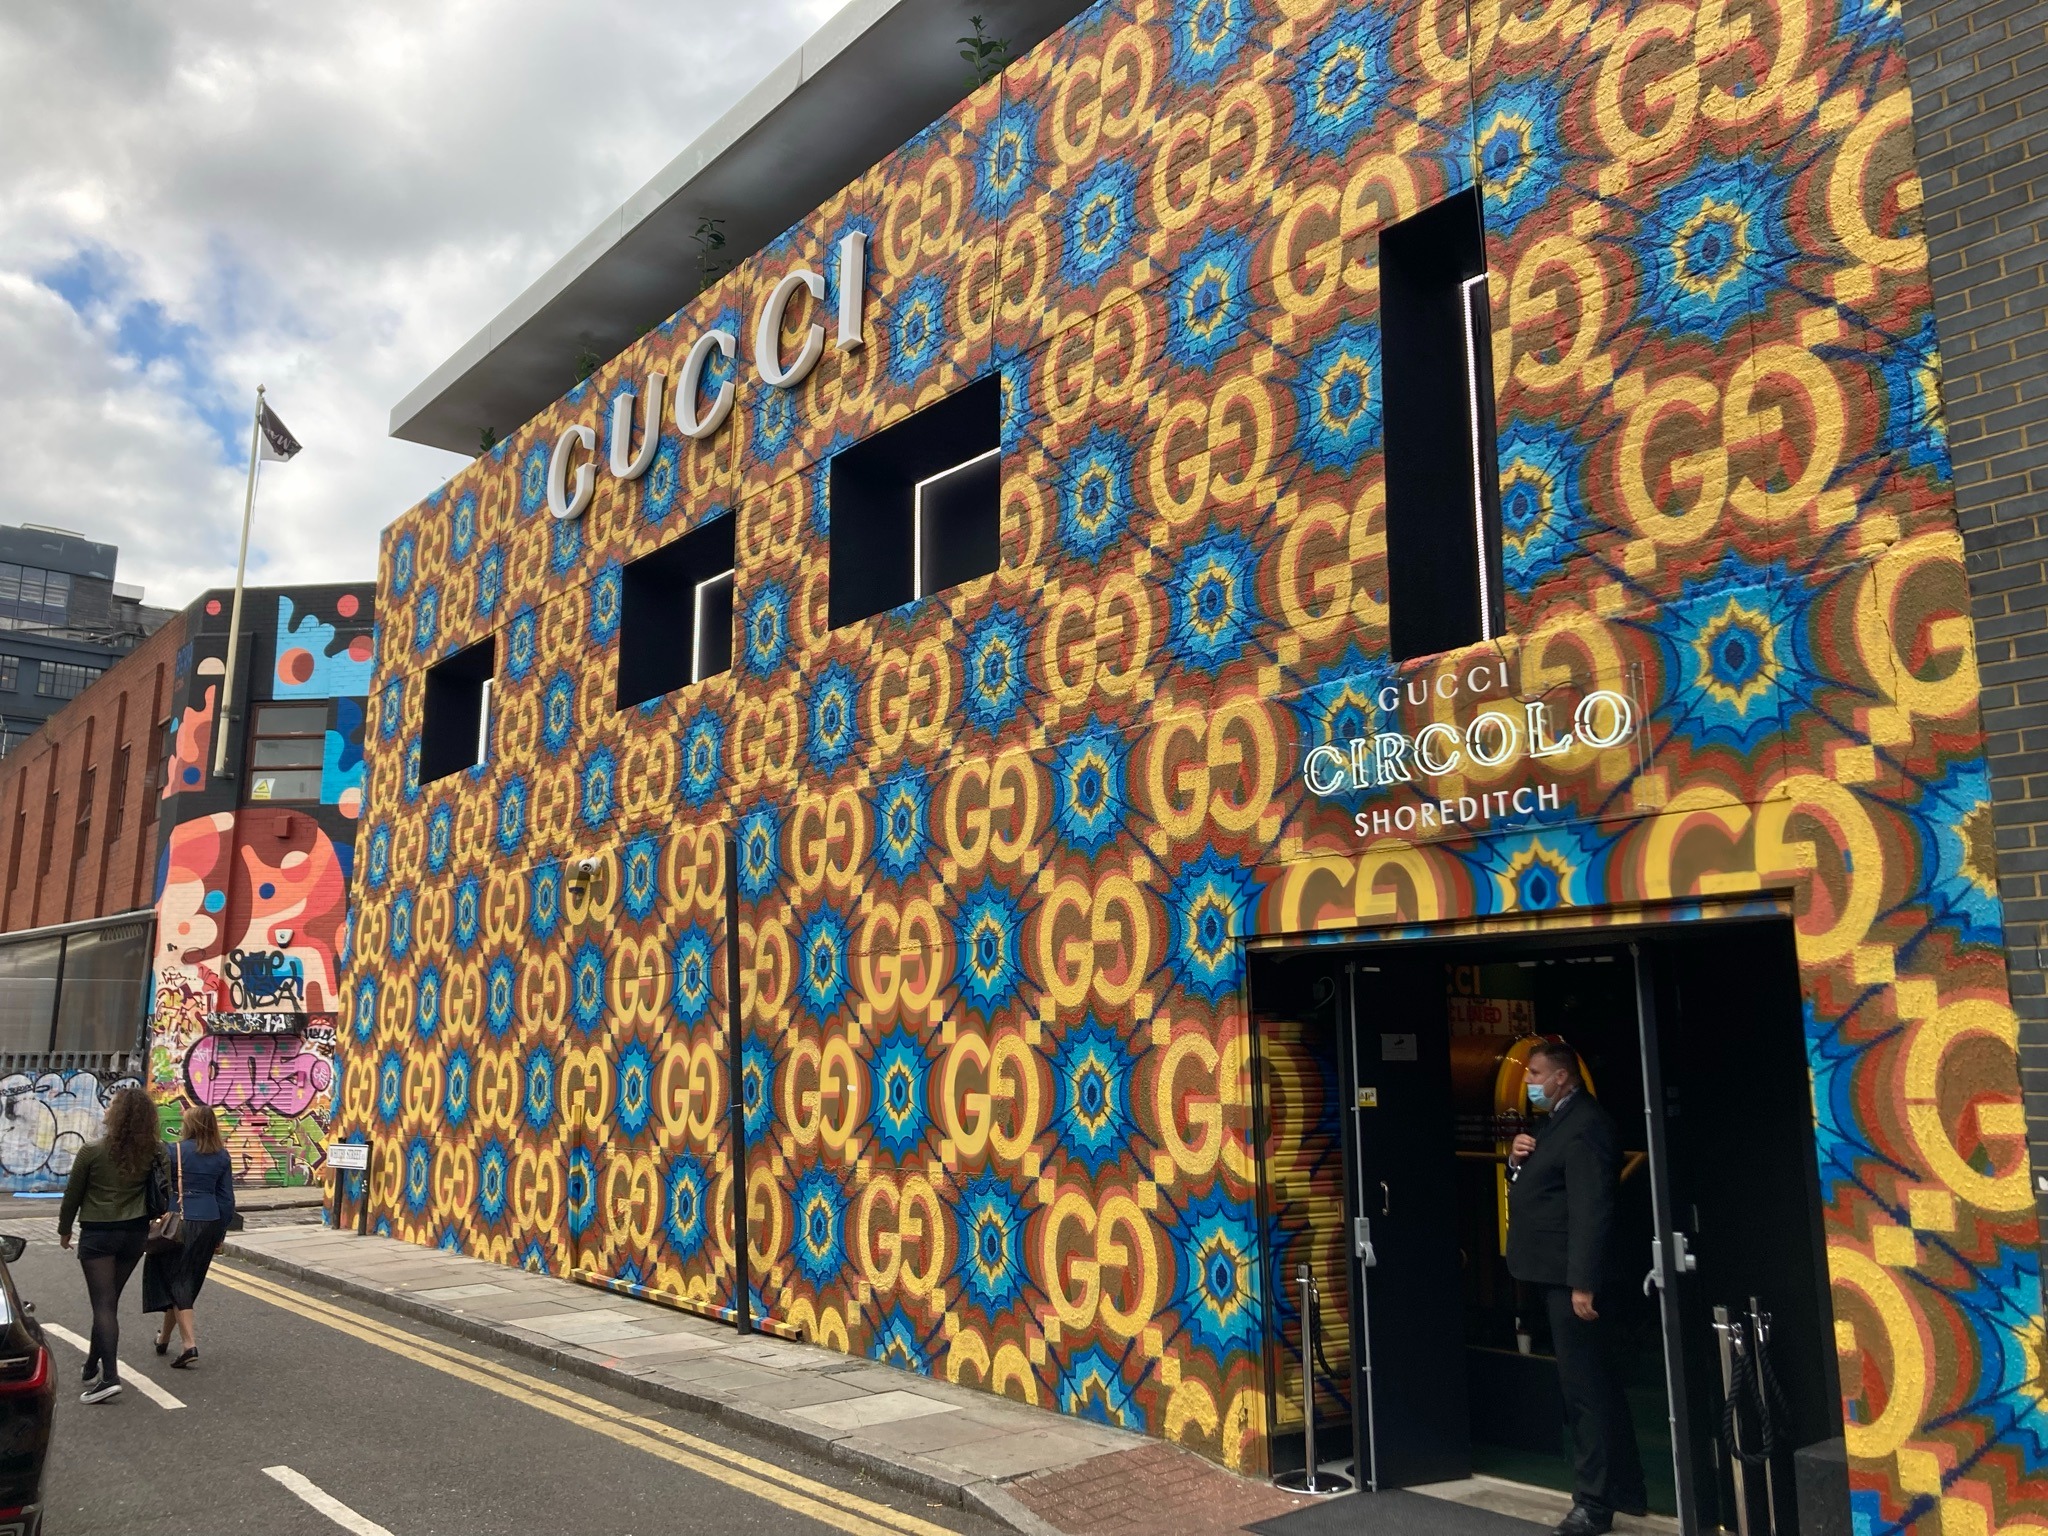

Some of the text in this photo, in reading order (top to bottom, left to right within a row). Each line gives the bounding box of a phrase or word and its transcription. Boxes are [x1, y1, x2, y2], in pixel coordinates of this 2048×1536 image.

[547, 231, 867, 519] GUCCI
[1378, 661, 1509, 712] GUCCI
[1303, 689, 1632, 797] CIRCOLO
[1354, 783, 1560, 838] SHOREDITCH
